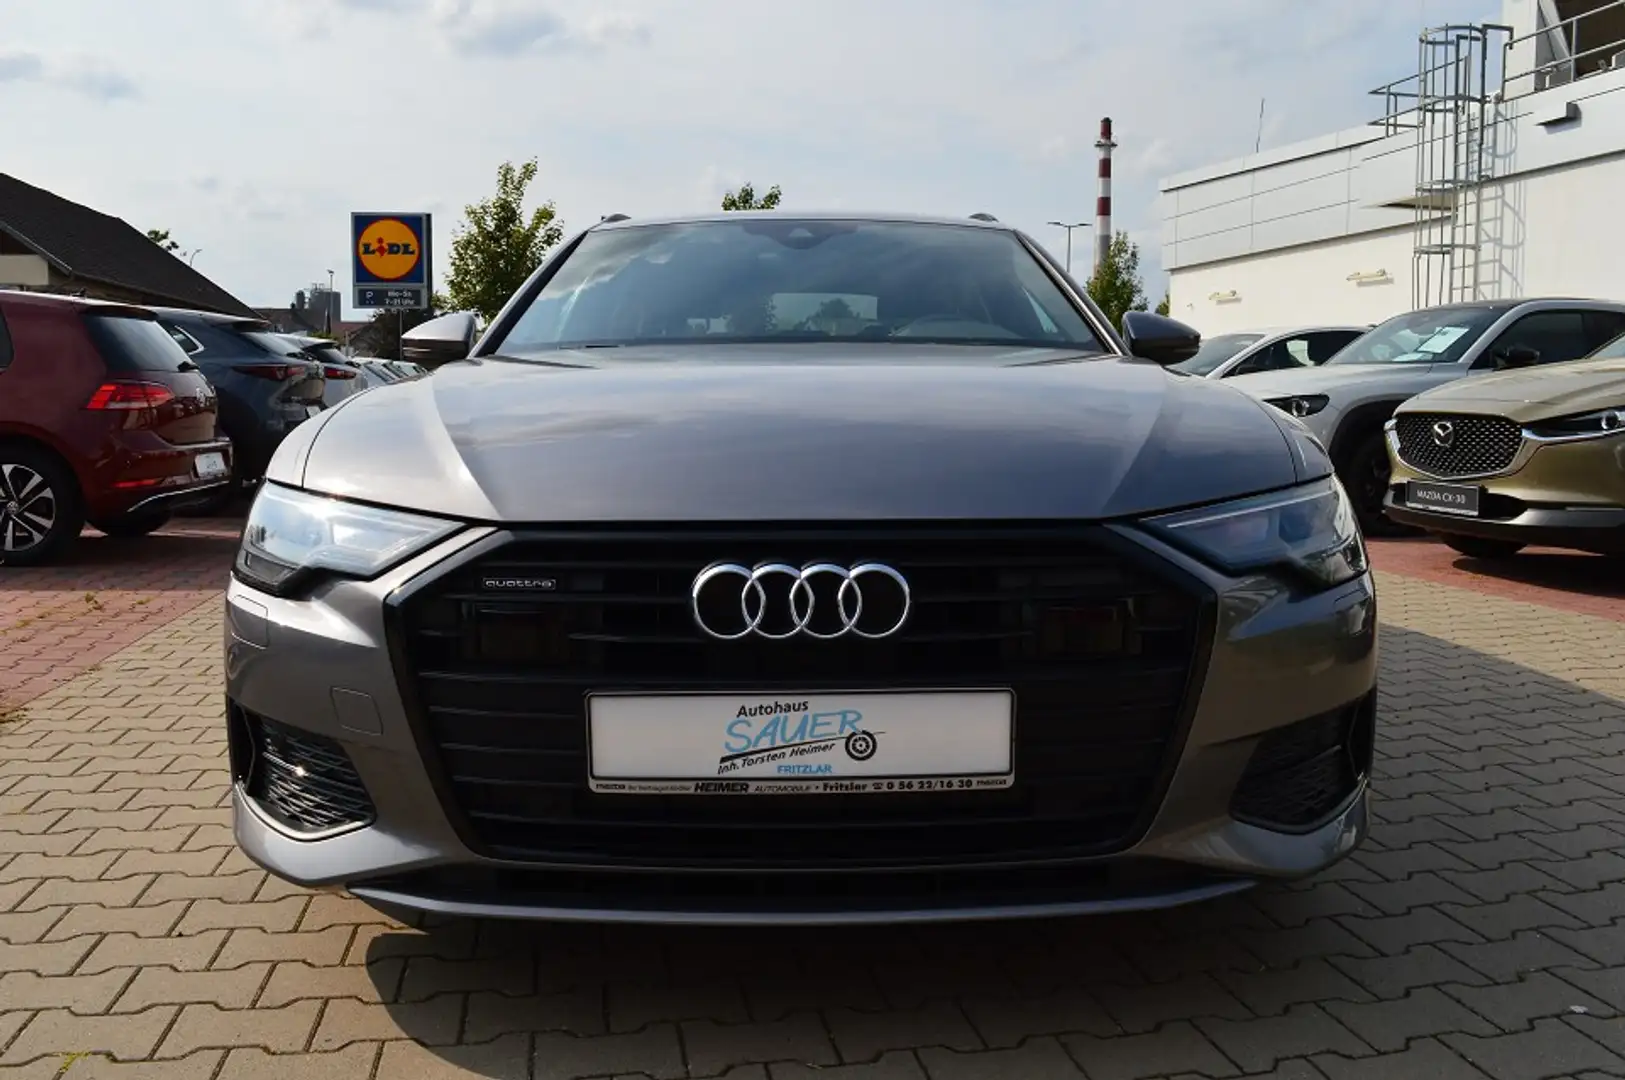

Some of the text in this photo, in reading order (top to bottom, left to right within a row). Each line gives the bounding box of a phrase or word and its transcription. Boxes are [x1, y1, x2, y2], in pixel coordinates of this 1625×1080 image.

[1416, 488, 1467, 504] MAZDA CX-30
[485, 580, 553, 588] quattro
[736, 700, 809, 719] Autohaus
[724, 709, 862, 753] SAUER
[717, 742, 836, 775] Inh. Torsten Heimer
[777, 764, 832, 775] FRITZLAR
[694, 782, 750, 793] HEIMER
[823, 782, 867, 792] Fritzlar
